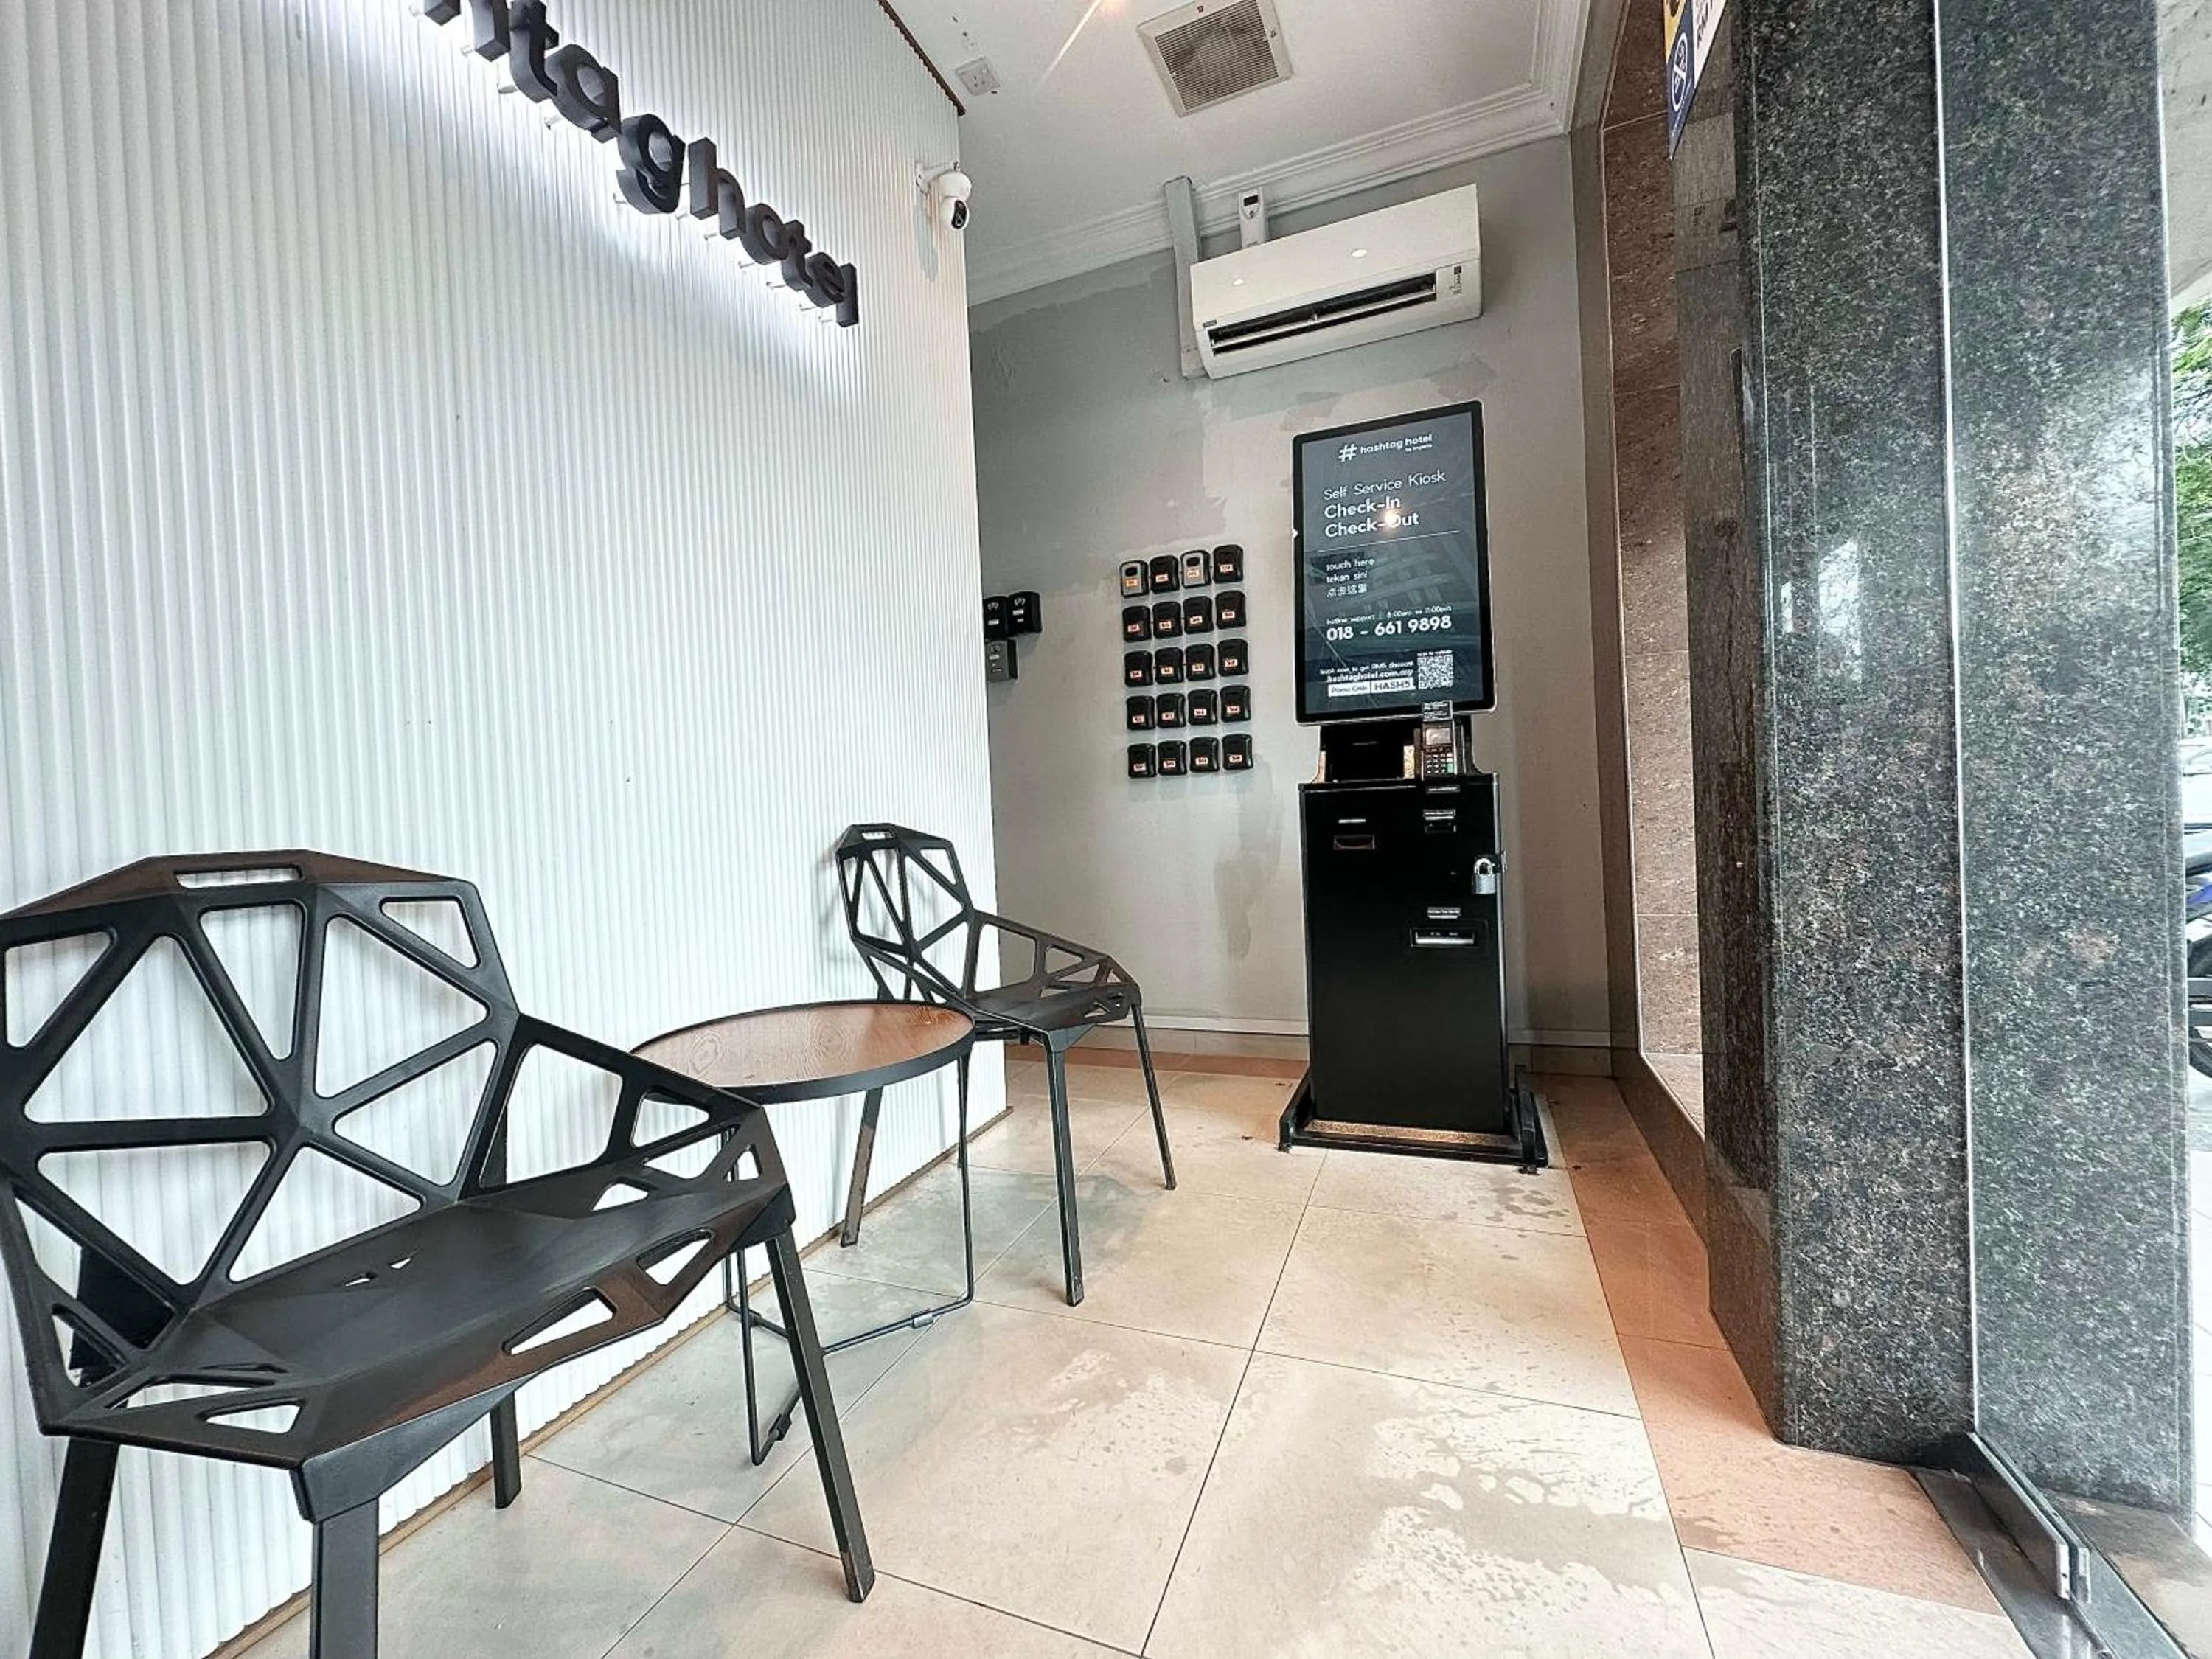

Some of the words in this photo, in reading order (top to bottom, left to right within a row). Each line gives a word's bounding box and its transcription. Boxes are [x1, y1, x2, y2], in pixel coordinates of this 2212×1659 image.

[1360, 440, 1404, 454] hashtag
[1405, 434, 1433, 446] hotel
[1324, 486, 1348, 501] Self
[1354, 479, 1403, 496] Service
[1408, 470, 1447, 487] Kiosk
[1324, 495, 1401, 518] Check-In
[1324, 512, 1419, 538] Check-Out
[1326, 560, 1352, 571] touch
[1353, 558, 1375, 568] here
[1326, 573, 1350, 583] tekan
[1326, 626, 1354, 641] 018
[1374, 620, 1402, 636] 661
[1408, 615, 1452, 633] 9898
[1326, 669, 1413, 684] hashtaghotel.com.my
